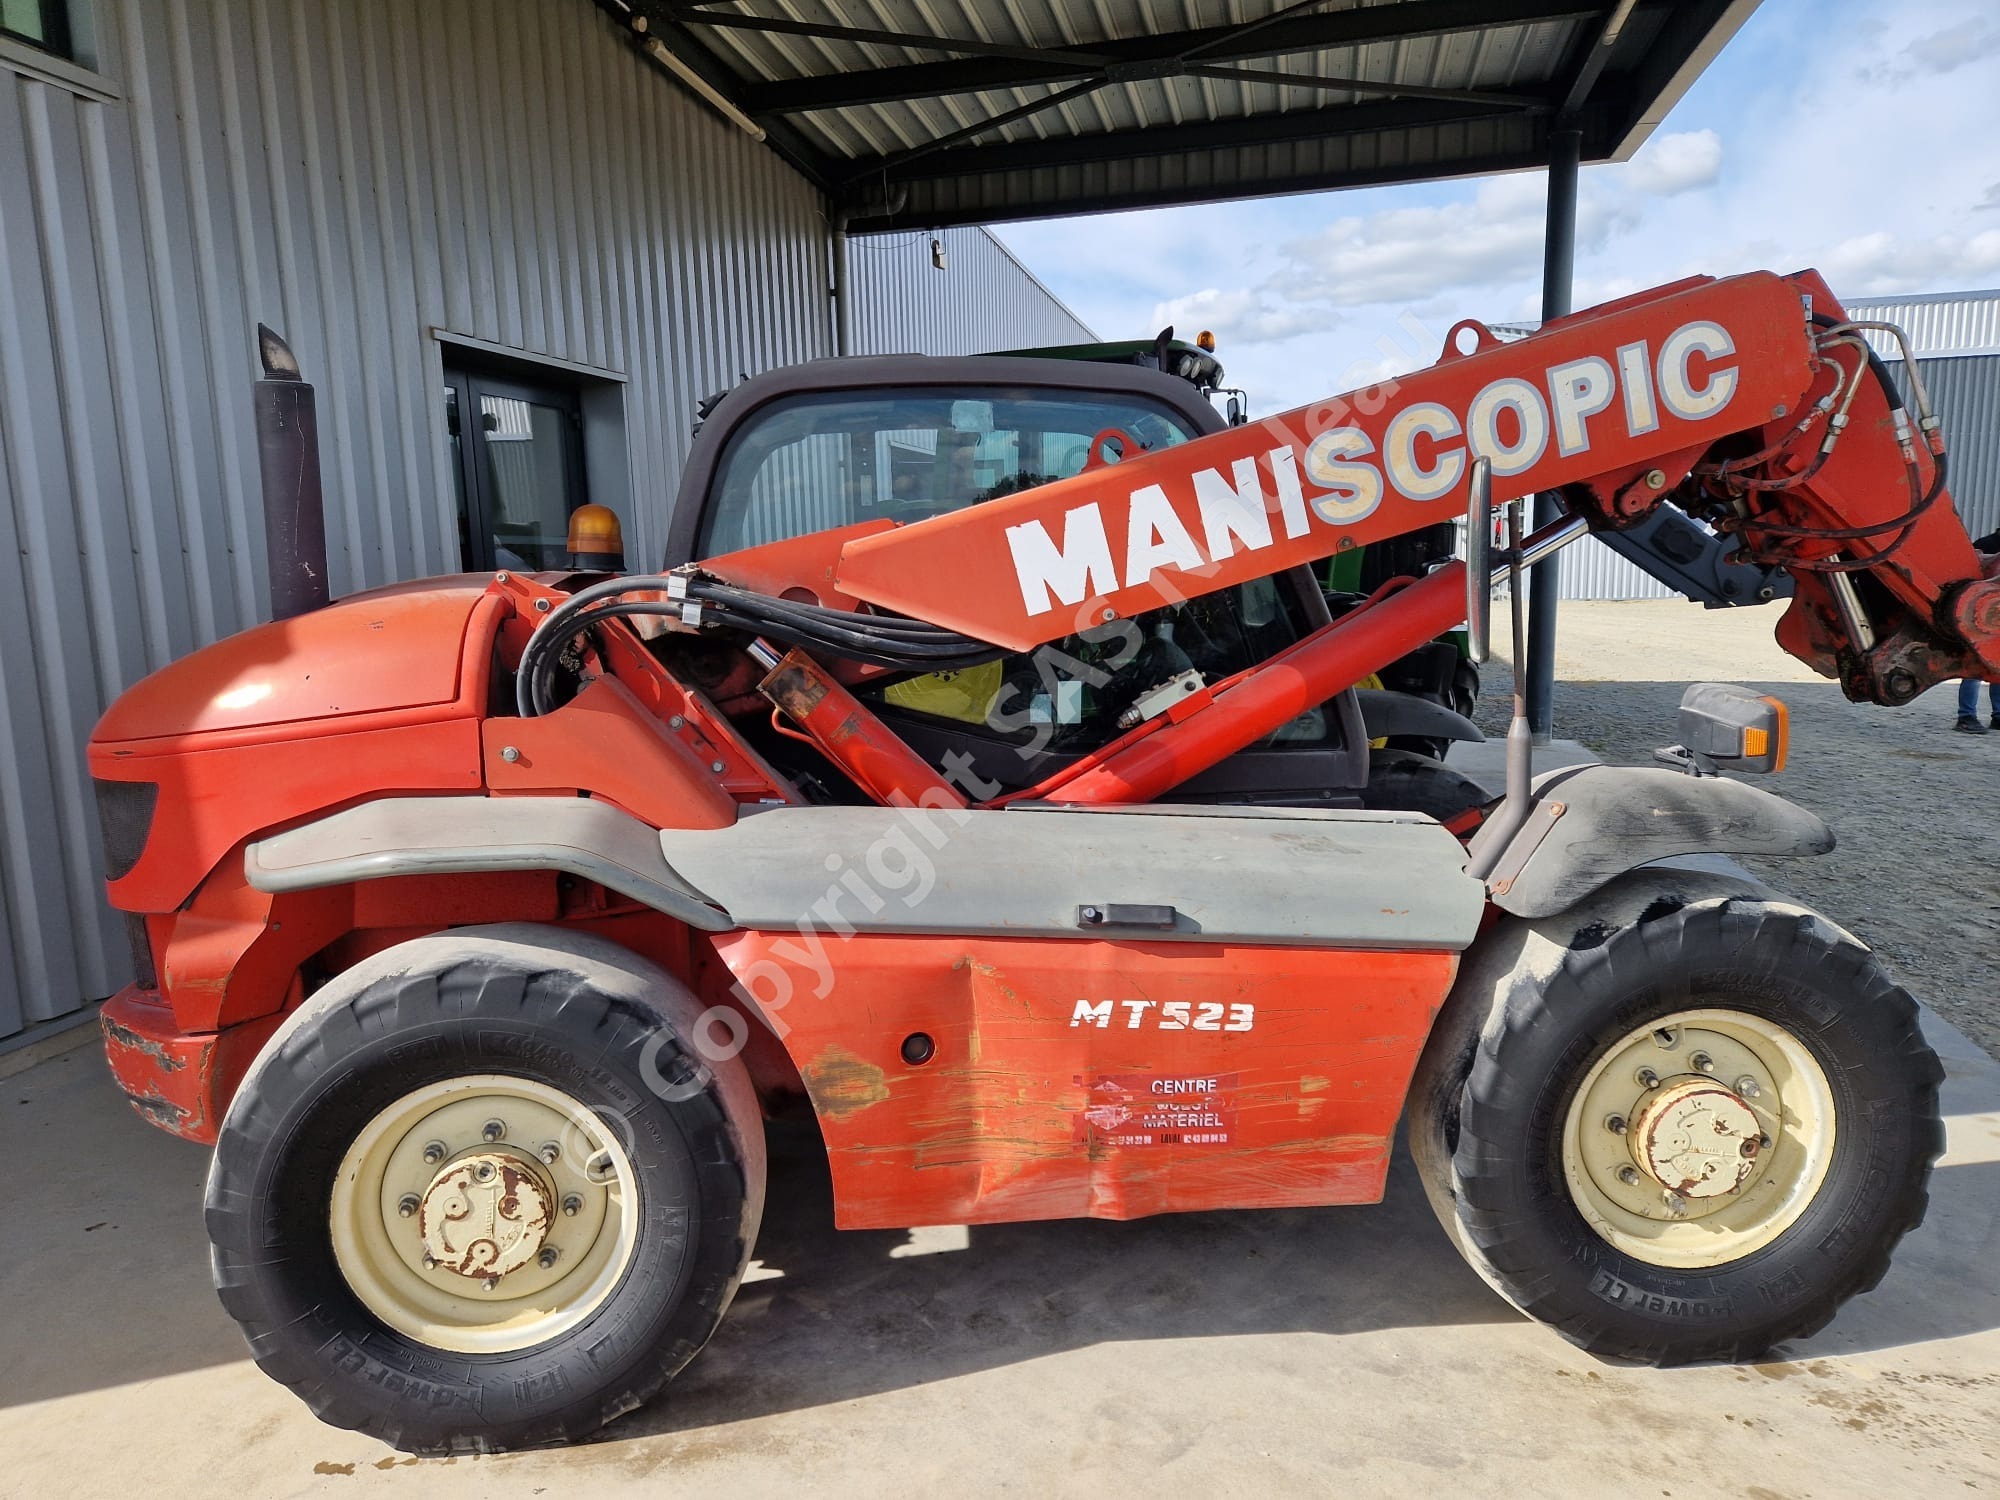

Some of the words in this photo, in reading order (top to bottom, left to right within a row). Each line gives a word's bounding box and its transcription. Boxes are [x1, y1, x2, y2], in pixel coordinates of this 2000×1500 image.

[1005, 320, 1739, 617] MANISCOPIC
[1151, 1079, 1217, 1094] CENTRE
[1142, 1113, 1224, 1129] MATERIEL
